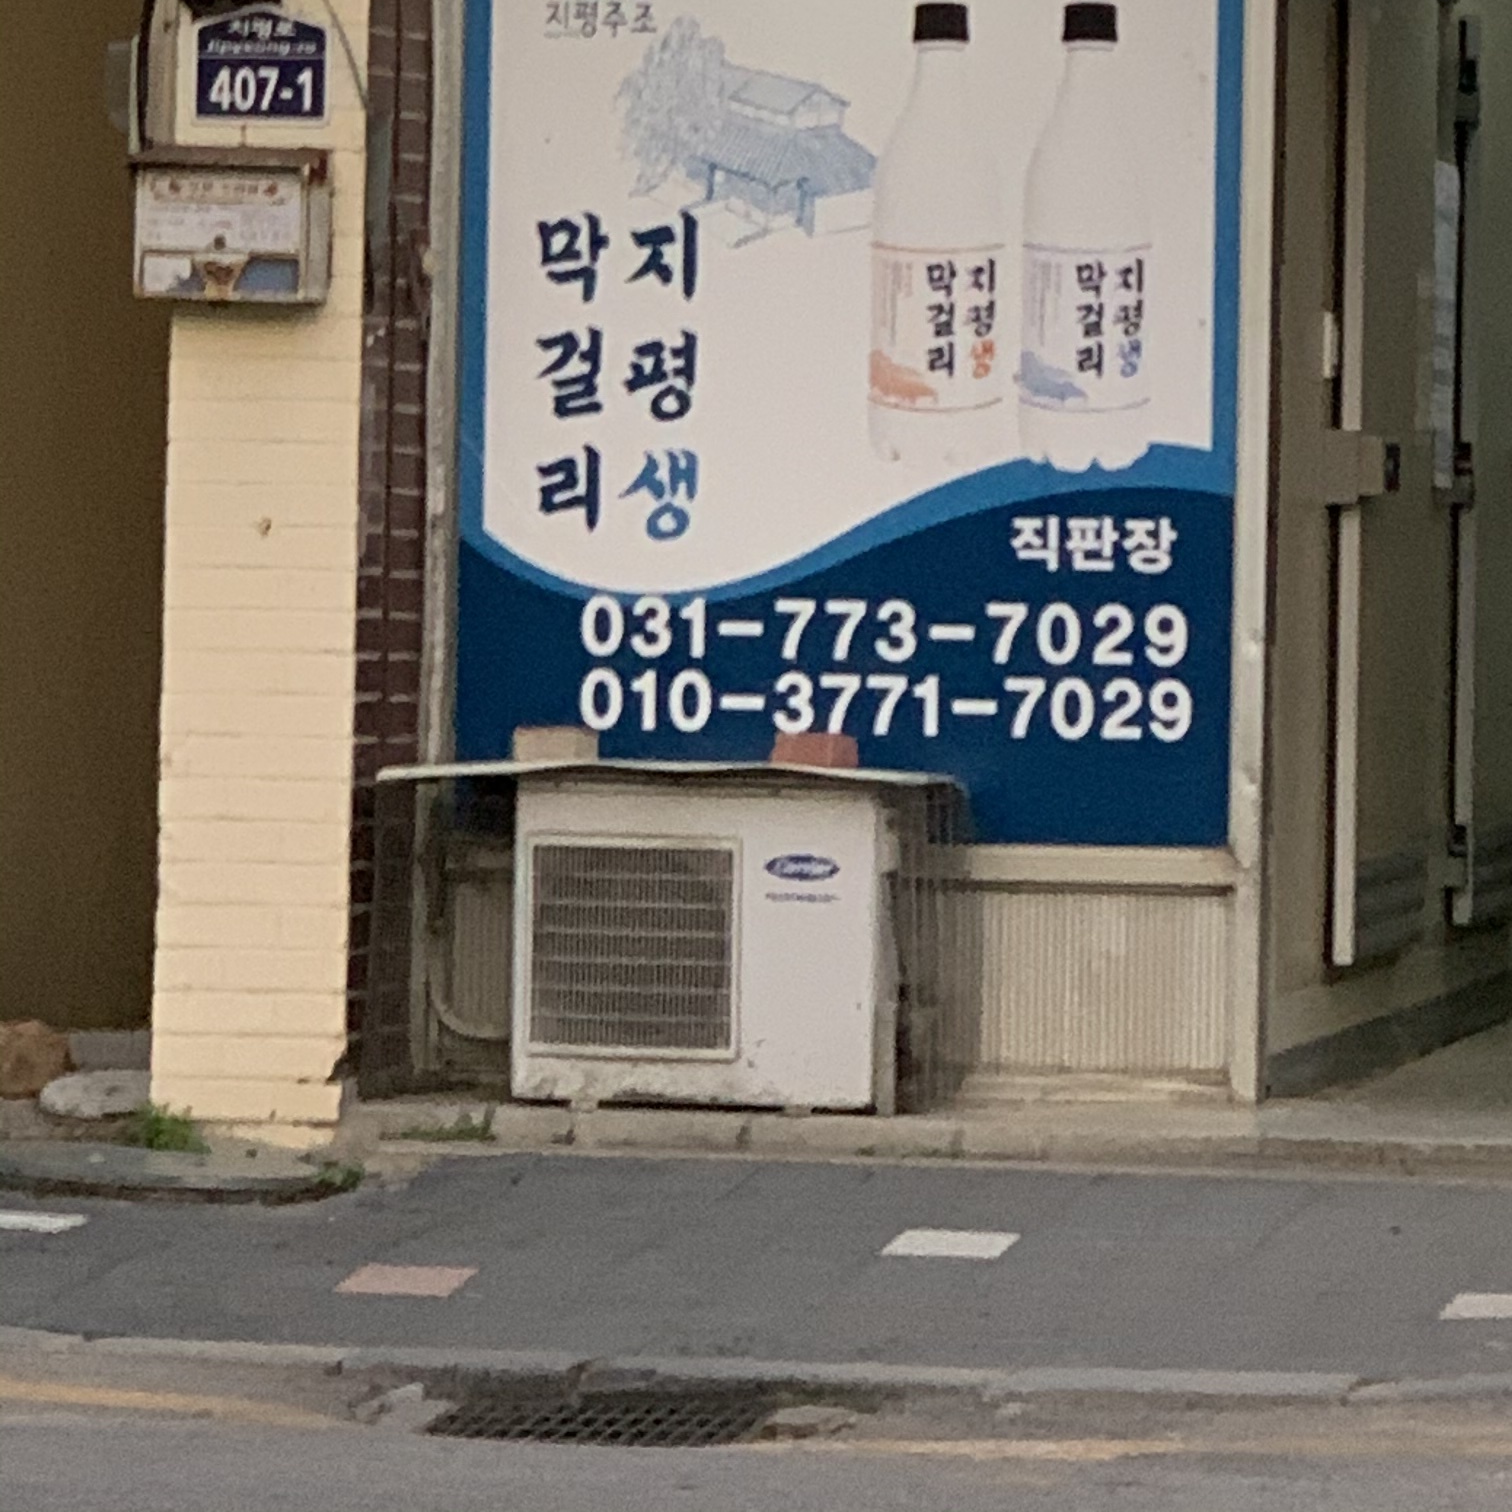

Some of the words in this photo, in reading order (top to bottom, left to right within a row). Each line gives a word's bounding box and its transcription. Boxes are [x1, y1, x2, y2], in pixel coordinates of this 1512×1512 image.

[544, 1, 658, 39] 지평주조
[208, 65, 313, 113] 407-1
[535, 209, 610, 534] 막걸리
[1010, 514, 1179, 573] 직판장
[579, 595, 1190, 667] 031-773-7029
[579, 667, 1194, 743] 010-3771-7029
